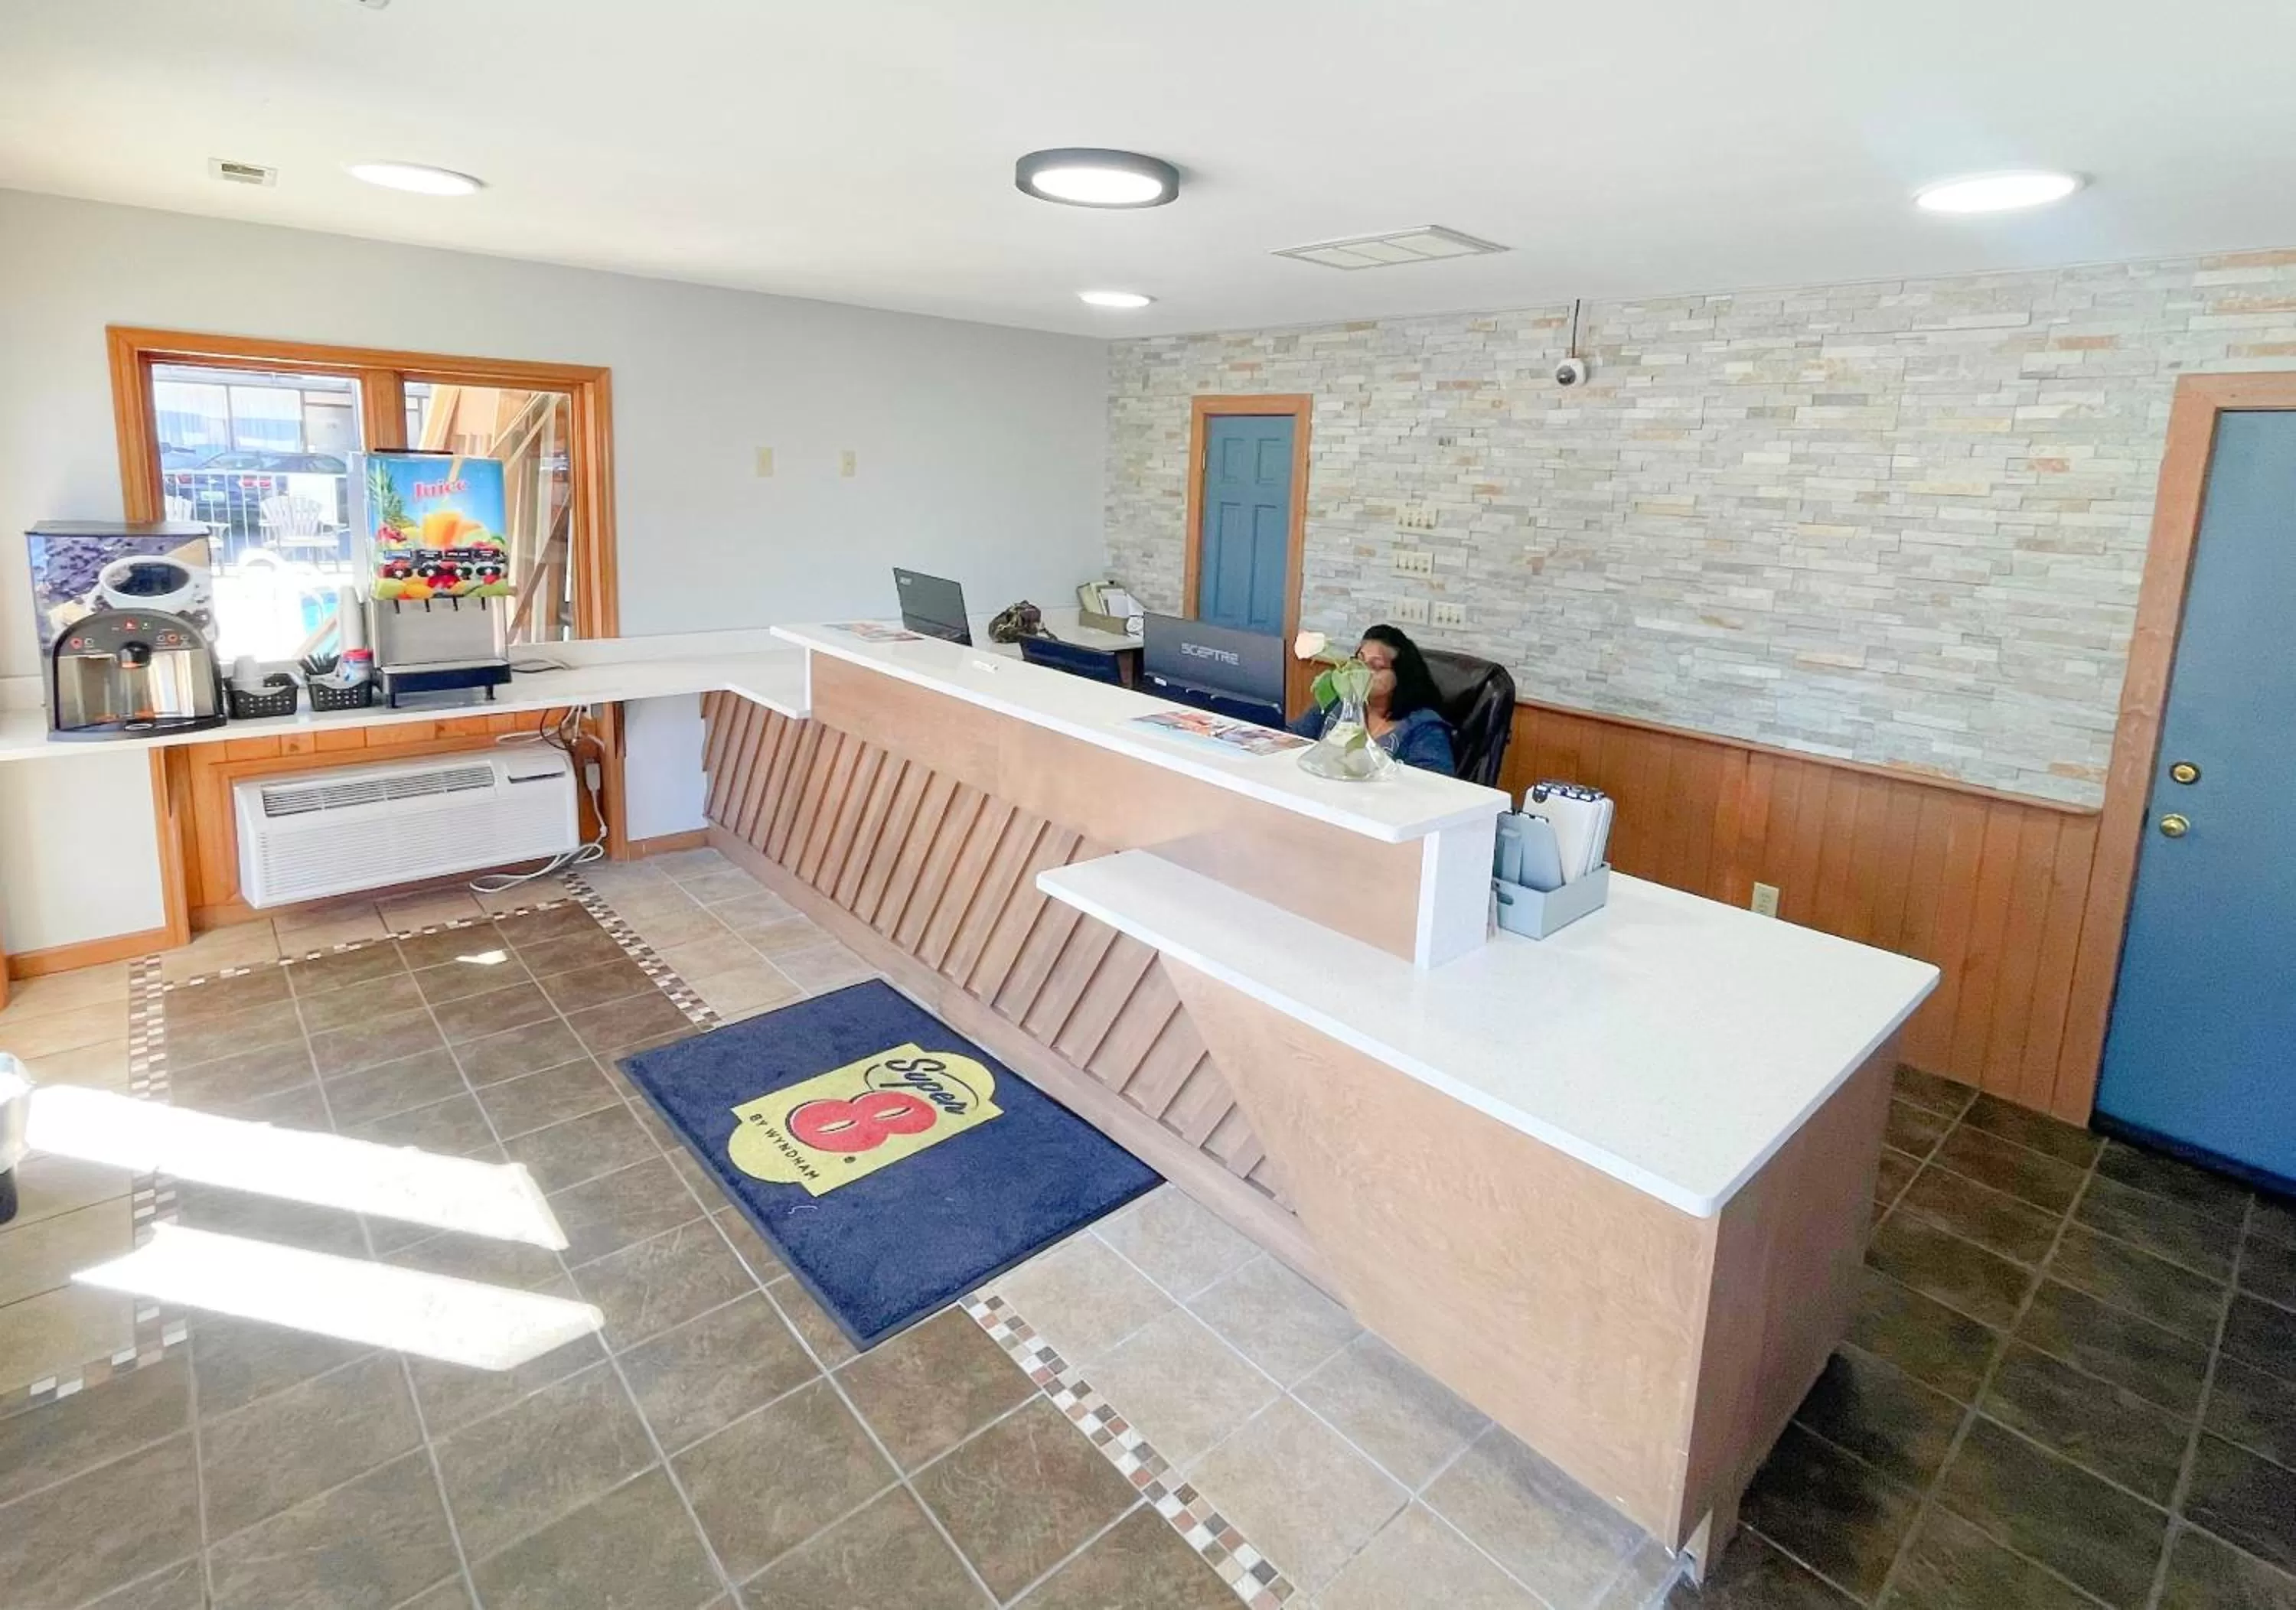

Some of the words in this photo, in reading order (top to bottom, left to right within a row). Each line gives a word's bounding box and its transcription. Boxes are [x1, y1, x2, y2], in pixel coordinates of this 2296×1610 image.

[414, 479, 467, 501] Juice
[1181, 643, 1240, 666] SCEPTRE
[879, 1058, 968, 1115] Super
[749, 1113, 768, 1127] BY
[765, 1128, 820, 1180] WYNDHAM
[785, 1090, 938, 1153] 8
